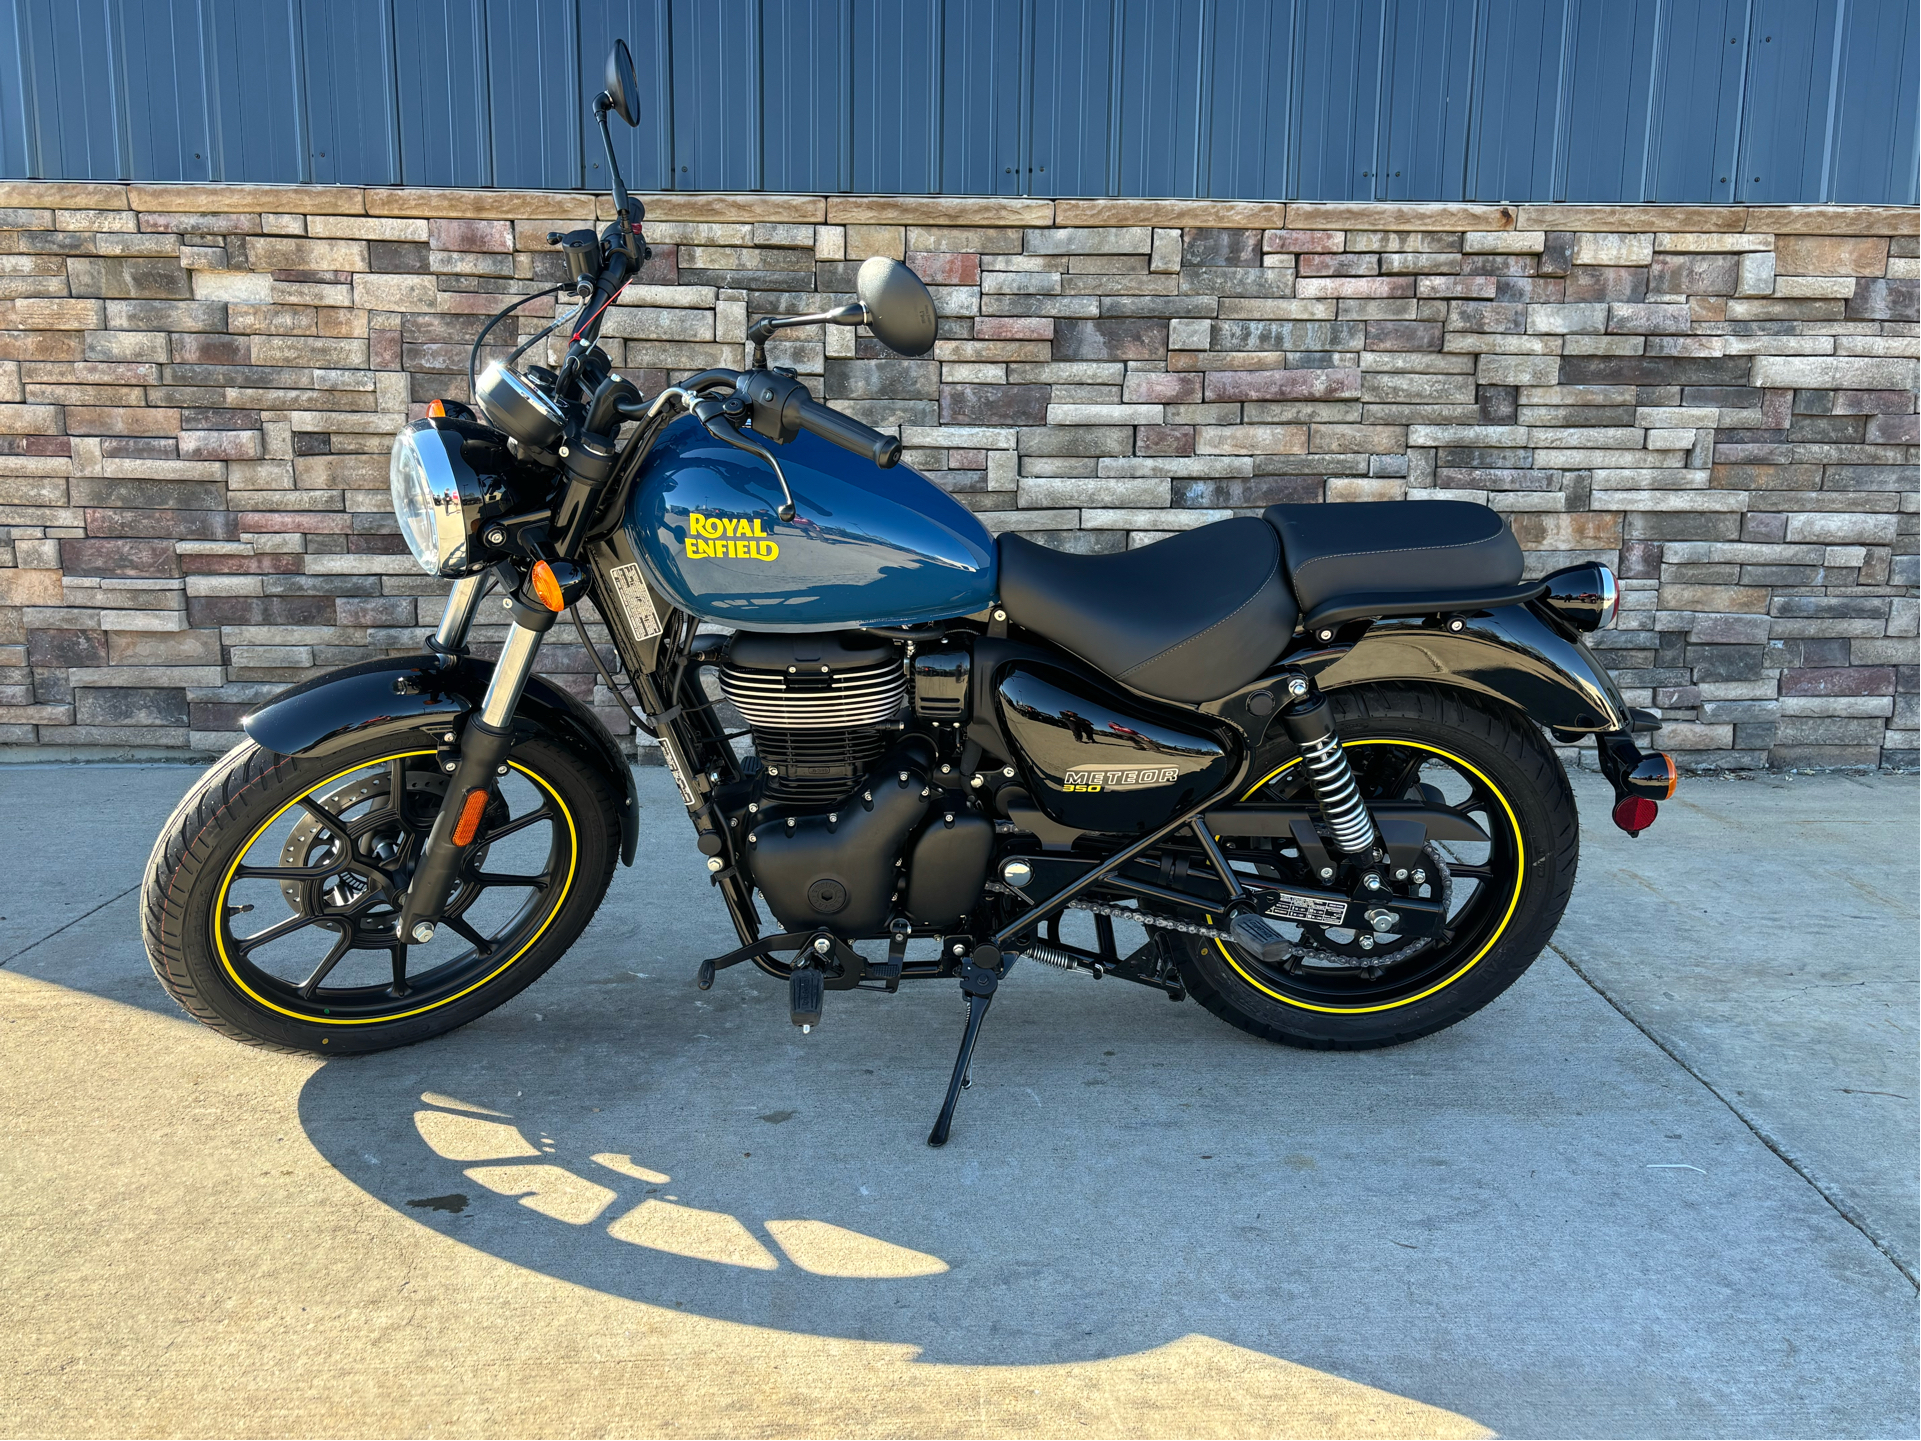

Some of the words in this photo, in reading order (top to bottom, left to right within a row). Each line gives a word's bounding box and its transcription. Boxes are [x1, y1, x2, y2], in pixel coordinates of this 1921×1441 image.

[690, 513, 767, 538] ROYAL
[685, 538, 779, 561] ENFIELD
[1064, 768, 1179, 785] METEOR
